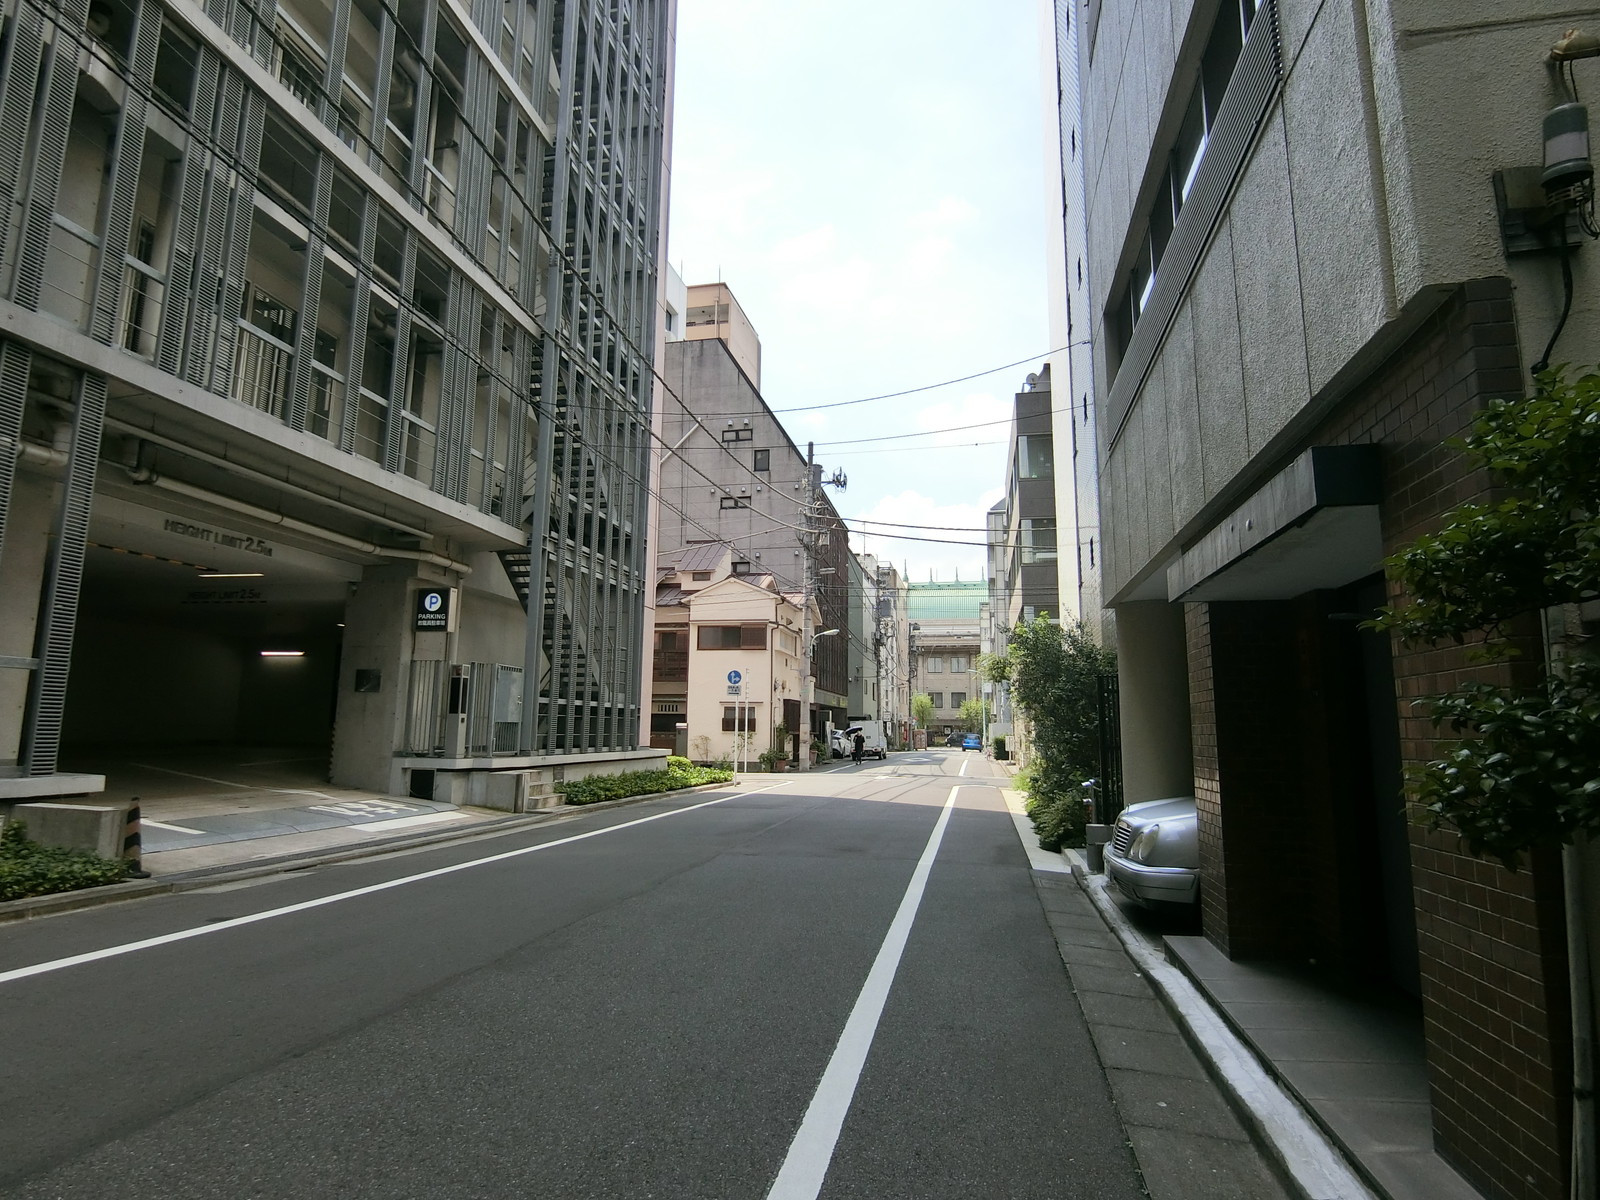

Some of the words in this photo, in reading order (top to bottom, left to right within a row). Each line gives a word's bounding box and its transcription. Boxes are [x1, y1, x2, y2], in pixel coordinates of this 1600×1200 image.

[164, 519, 213, 541] HEIGHT
[214, 532, 245, 549] LIMIT
[429, 595, 439, 609] P
